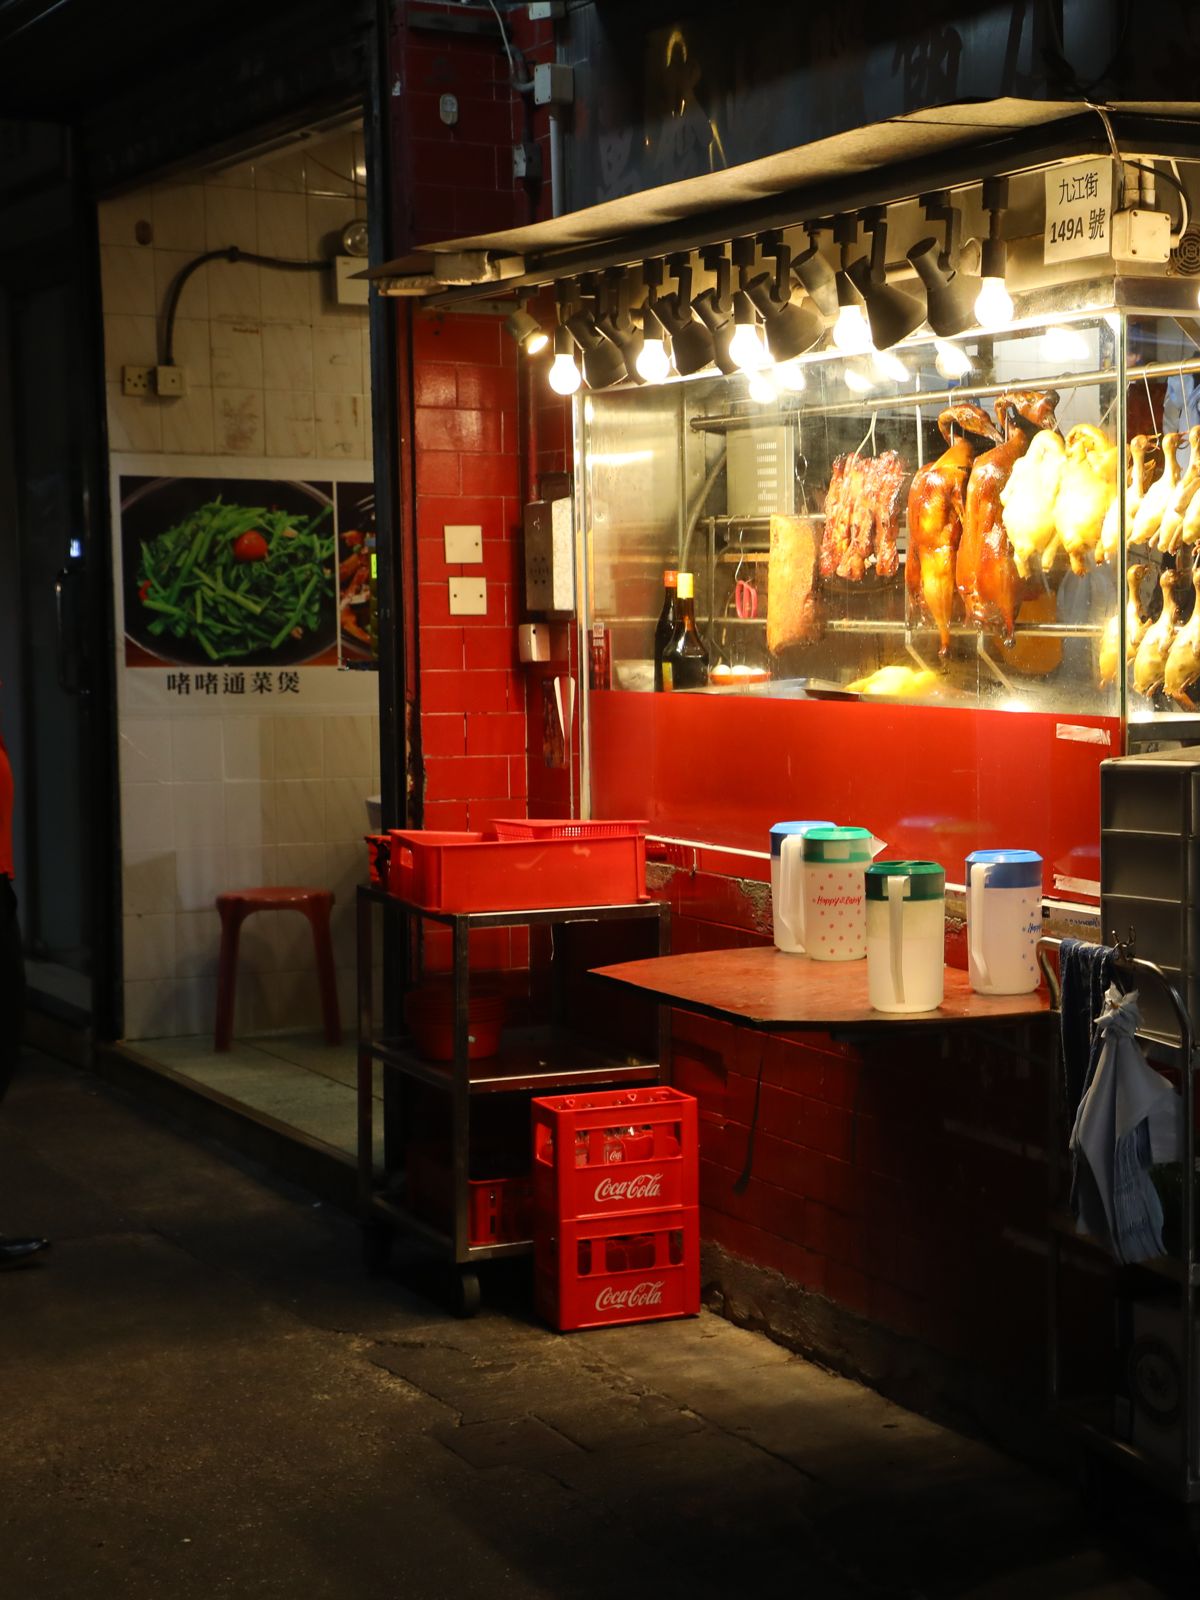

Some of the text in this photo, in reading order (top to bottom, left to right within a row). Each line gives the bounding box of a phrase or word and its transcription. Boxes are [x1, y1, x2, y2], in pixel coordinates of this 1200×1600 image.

[1058, 172, 1099, 205] 九江街
[1050, 207, 1106, 244] 149A 號
[167, 671, 300, 695] 啫啫通菜煲
